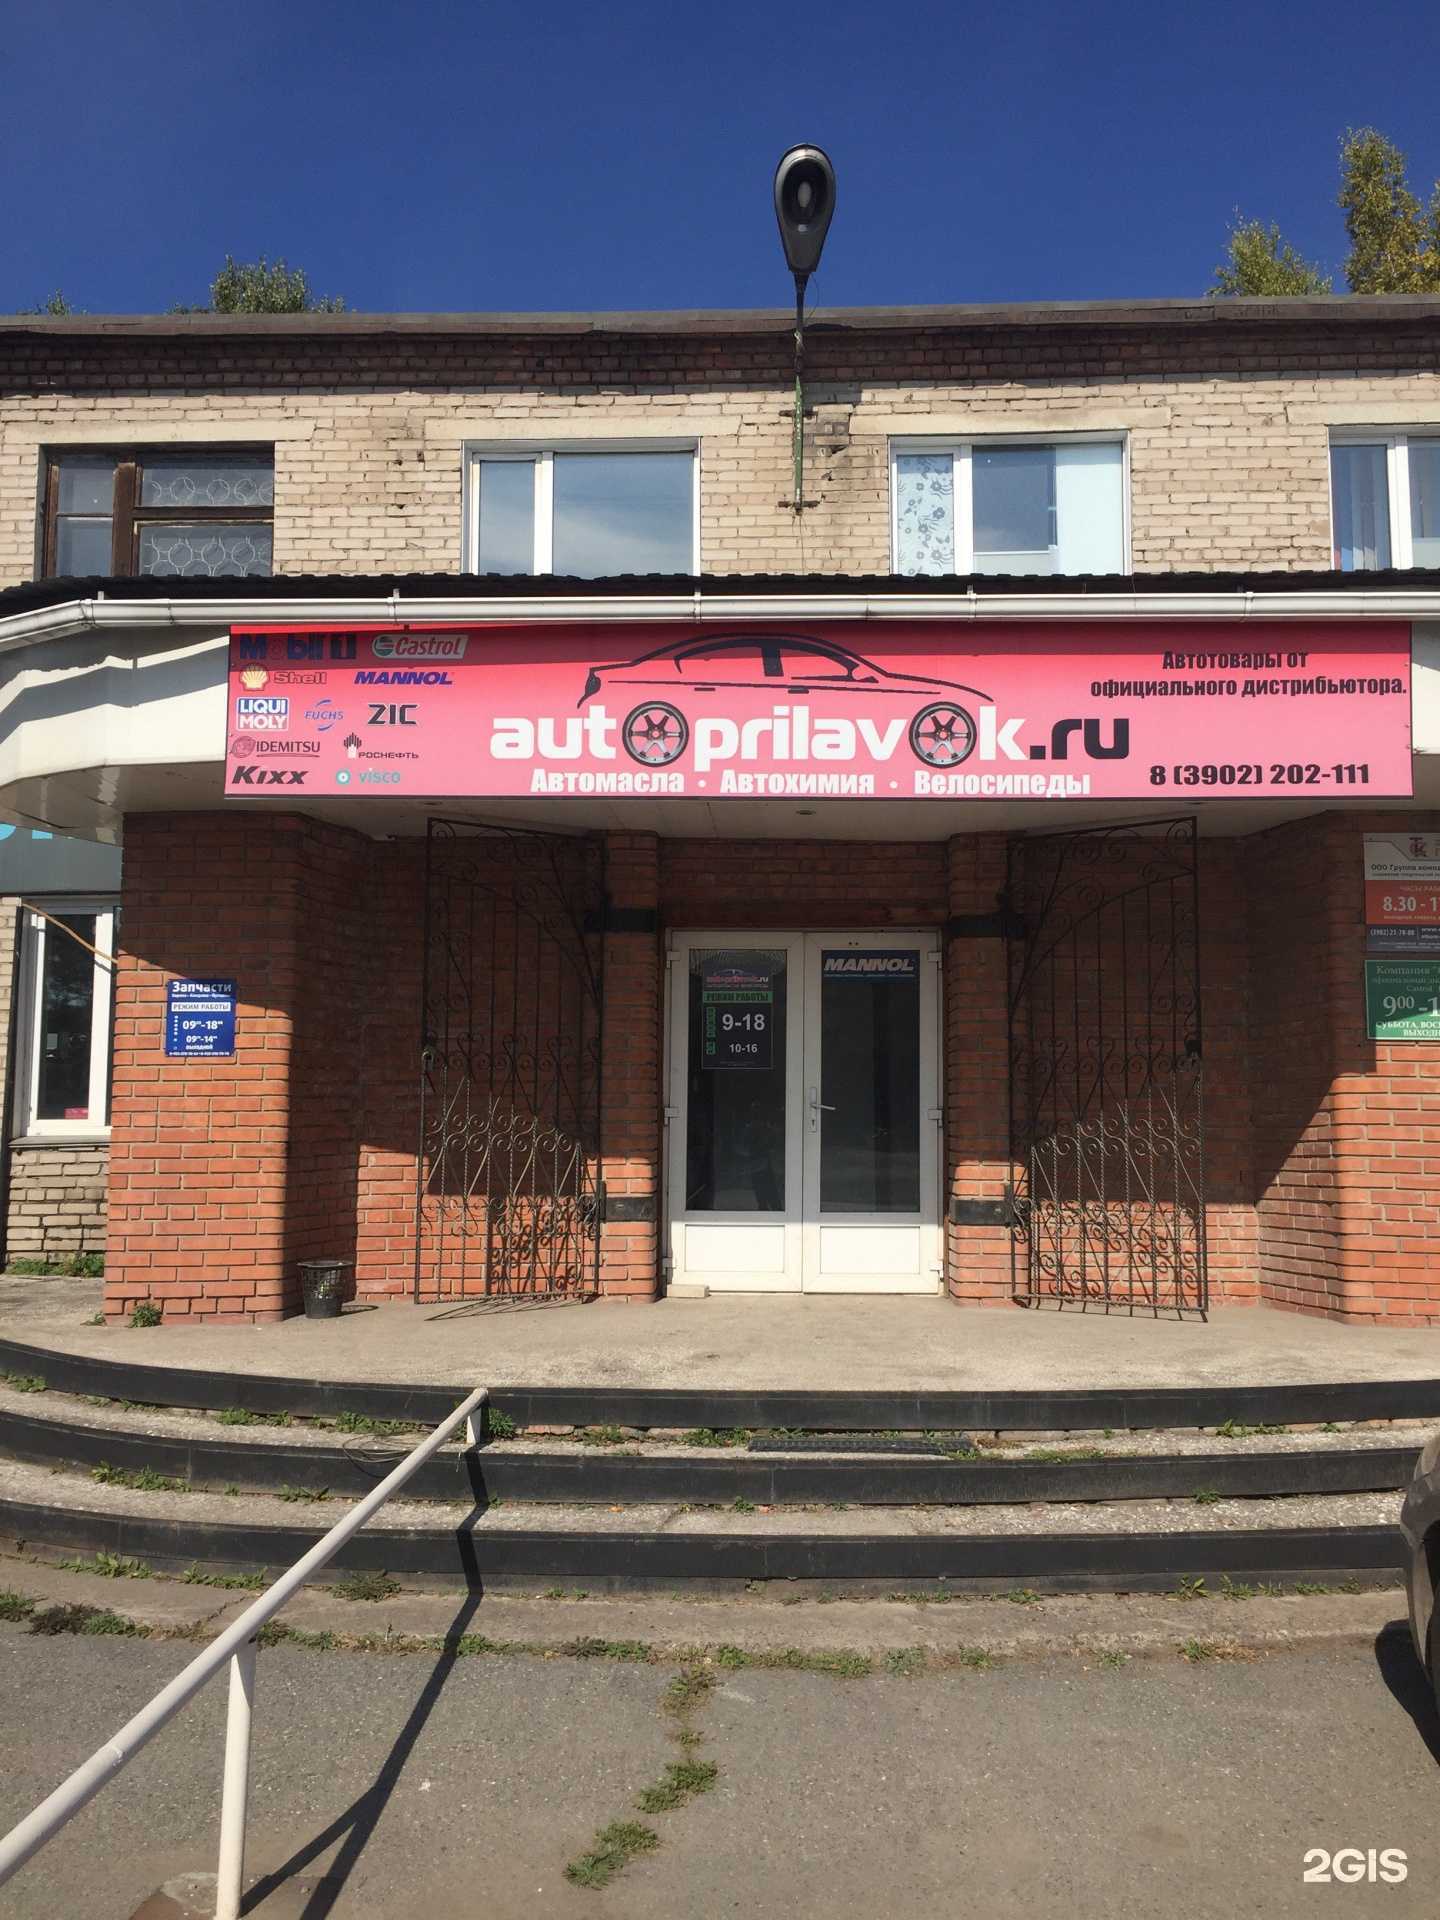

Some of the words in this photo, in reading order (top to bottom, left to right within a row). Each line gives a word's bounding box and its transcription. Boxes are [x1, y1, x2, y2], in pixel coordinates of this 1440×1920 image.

[395, 636, 462, 656] Castrol
[1161, 650, 1281, 670] Автотовары
[1286, 651, 1309, 668] от
[273, 671, 328, 685] Shell
[353, 671, 453, 685] MANNOL
[1090, 678, 1237, 699] официального
[1241, 675, 1408, 698] дистрибьютора.
[240, 699, 286, 714] LIQUI
[367, 703, 418, 725] ZIC
[239, 715, 287, 730] MOLY
[304, 710, 344, 721] FUCHS
[256, 740, 321, 754] IDEMITSU
[358, 751, 420, 759] РОСНЕФТЬ
[359, 768, 401, 785] visco
[1149, 765, 1167, 786] 8
[1173, 764, 1263, 786] (3902)
[1269, 763, 1369, 785] 202-111
[530, 768, 685, 794] Автомасла
[720, 769, 875, 795] Автохимия
[914, 770, 1091, 798] Велосипеды
[1383, 896, 1417, 912] 8.30
[824, 958, 914, 971] MANNOL
[172, 981, 232, 992] Запчасти
[173, 1002, 199, 1010] РЕЖИМ
[201, 1002, 229, 1010] РАБОТЫ
[722, 1013, 766, 1031] 9-18
[728, 1043, 759, 1054] 10-16
